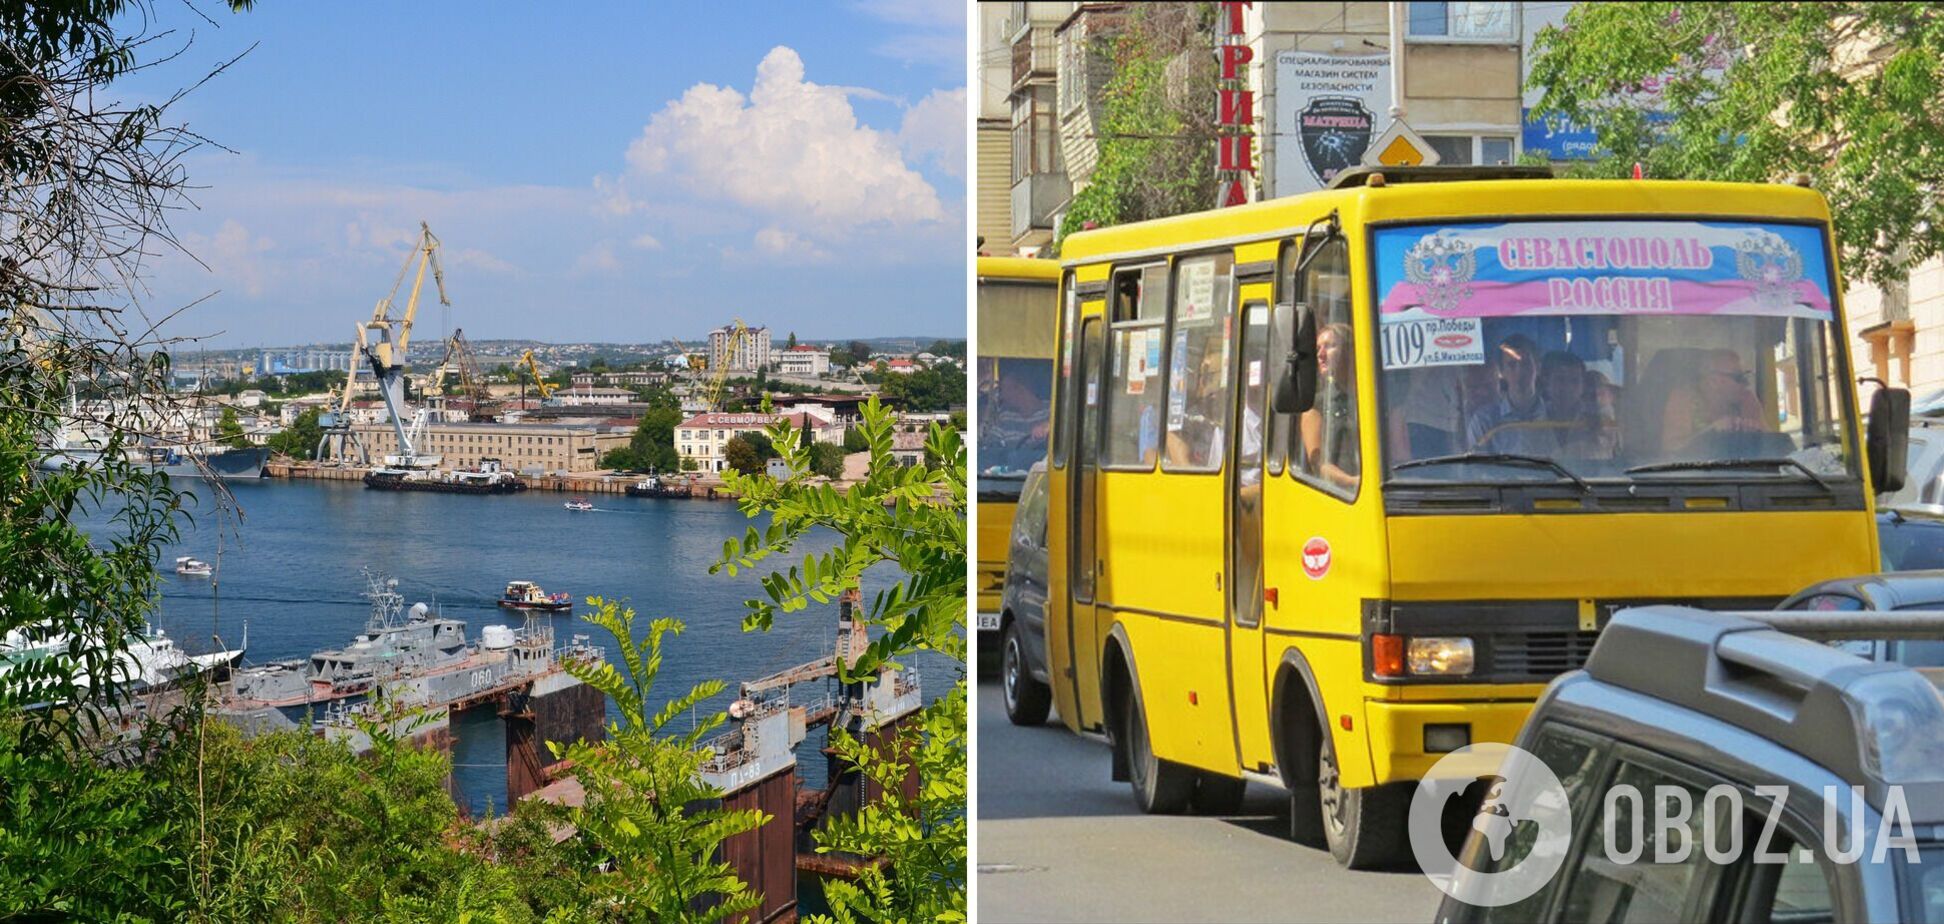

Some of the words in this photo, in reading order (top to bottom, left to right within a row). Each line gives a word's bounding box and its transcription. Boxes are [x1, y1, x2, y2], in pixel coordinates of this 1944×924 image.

[1295, 69, 1340, 78] МАГАЗИН
[1341, 71, 1378, 79] СИСТЕМ
[1301, 82, 1374, 92] БЕЗОПАСНОСТИ
[1499, 236, 1713, 270] СЕВАСТОПОЛЬ
[1550, 278, 1673, 309] РОССИЯ
[1383, 322, 1424, 366] 109
